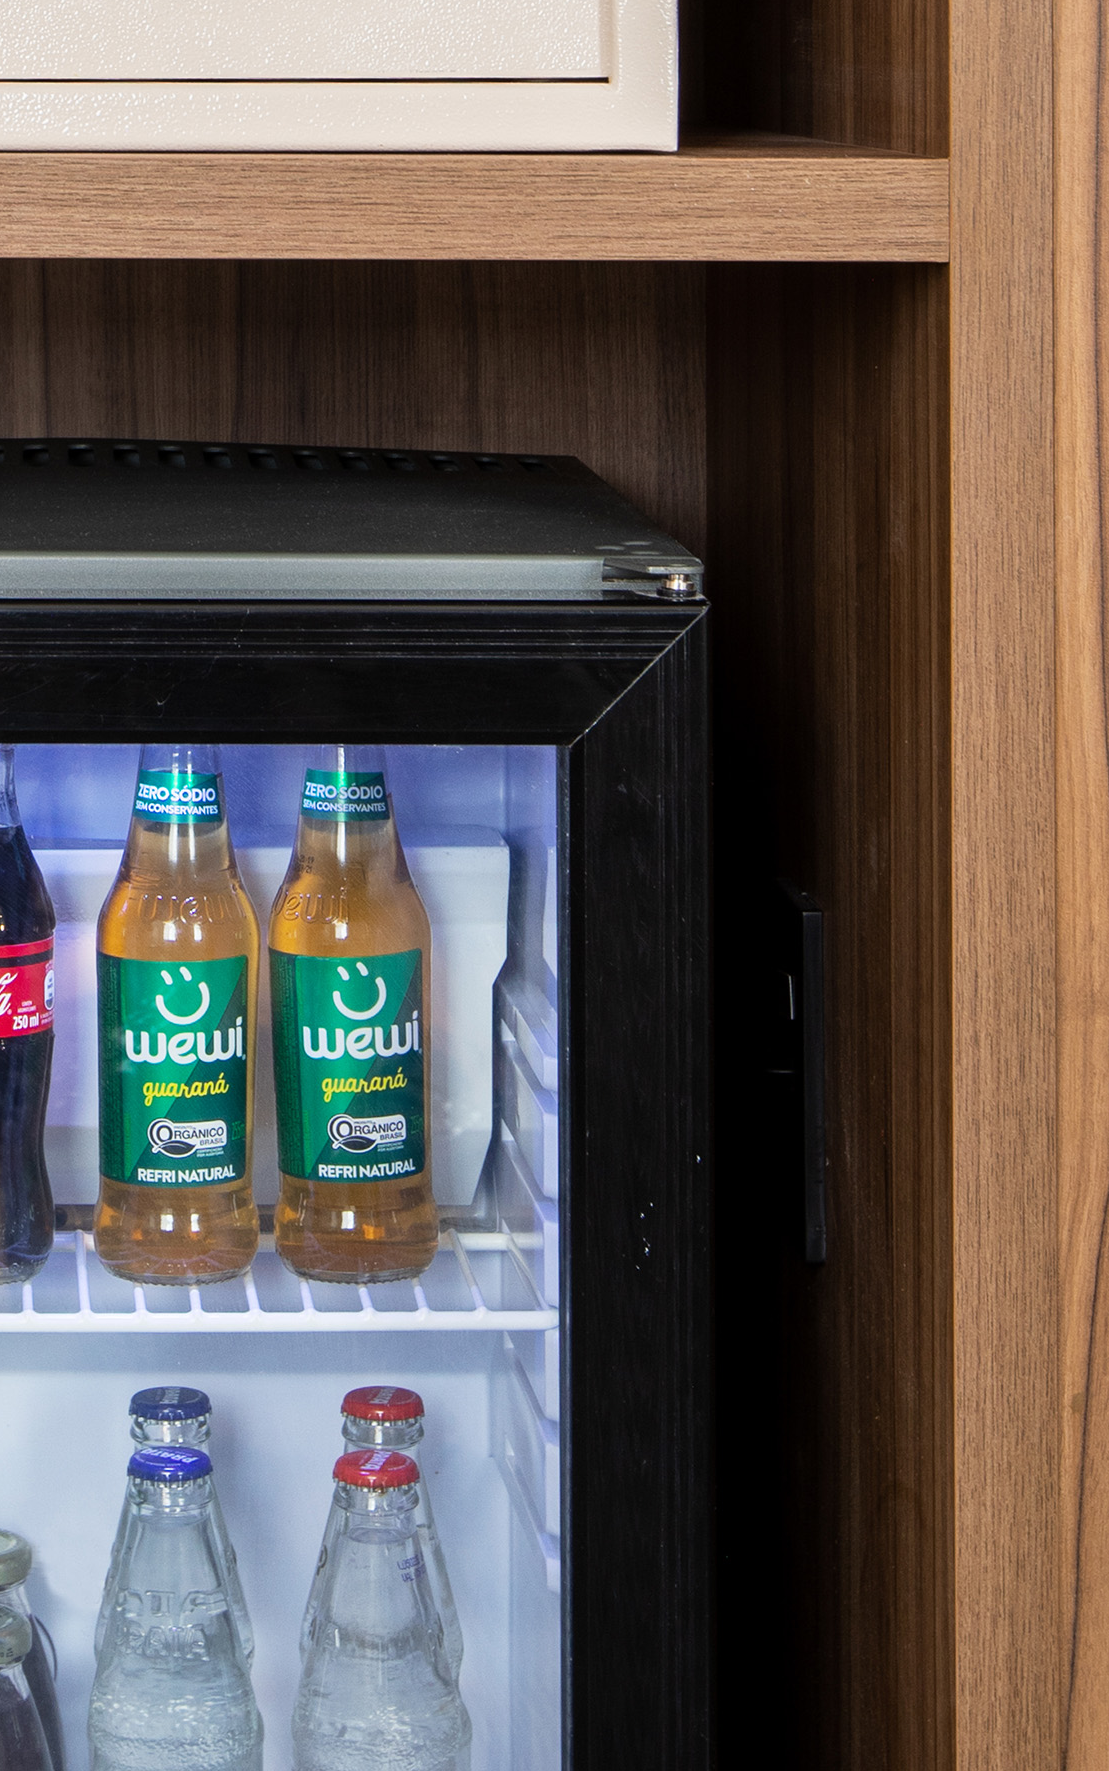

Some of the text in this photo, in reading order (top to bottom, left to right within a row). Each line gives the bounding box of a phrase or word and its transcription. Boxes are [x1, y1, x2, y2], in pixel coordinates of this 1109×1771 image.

[138, 783, 216, 802] ZERO SÓDIO
[305, 781, 383, 799] ZERO SÓDIO
[135, 800, 218, 815] SEM CONSERVANTES
[302, 798, 386, 812] SEM CONSERVANTES
[12, 1014, 28, 1030] 250
[29, 1012, 40, 1028] ml
[125, 1016, 243, 1065] wewi
[303, 1011, 419, 1060] wewi
[143, 1072, 229, 1107] guaraná
[322, 1067, 407, 1104] guaraná
[156, 1124, 224, 1142] ORGÂNICO
[336, 1120, 403, 1138] ORGÂNICO
[379, 1133, 404, 1141] BRASIL
[199, 1139, 224, 1147] BRASIL
[137, 1166, 235, 1182] REFRI NATURAL
[318, 1158, 416, 1178] REFRI NATURAL
[140, 1448, 199, 1465] PRATA
